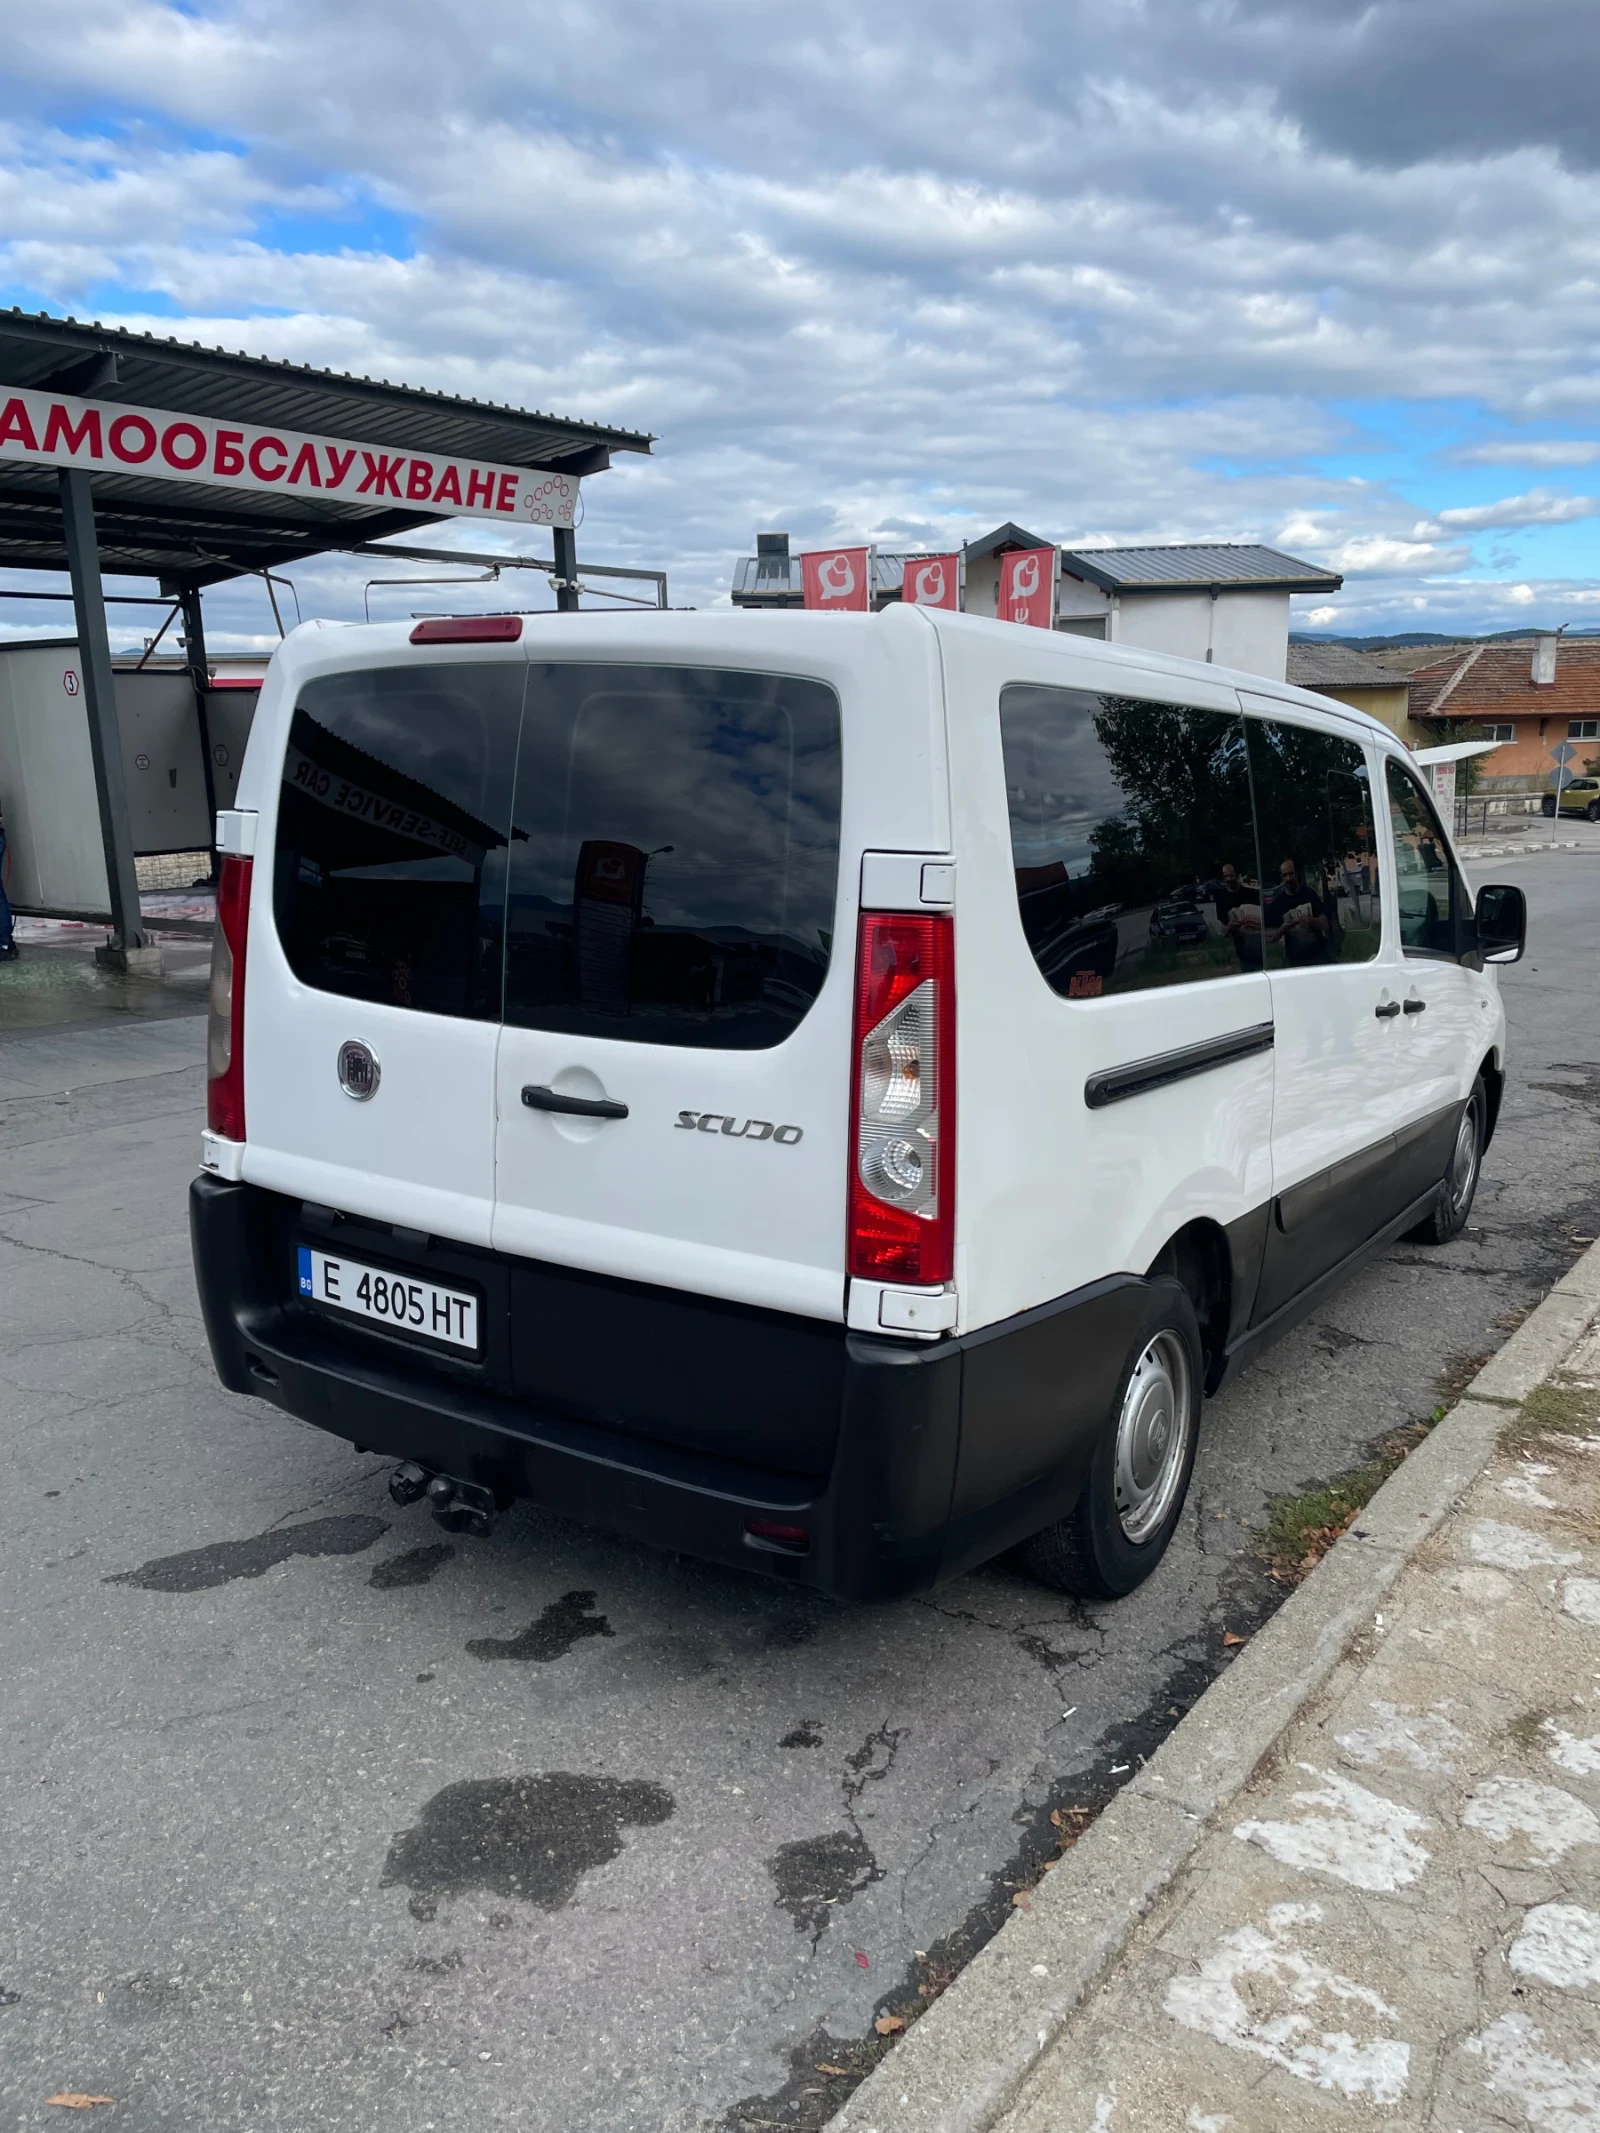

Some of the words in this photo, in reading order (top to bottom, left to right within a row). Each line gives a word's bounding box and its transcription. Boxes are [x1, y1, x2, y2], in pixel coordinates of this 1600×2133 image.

[0, 397, 519, 512] АМООБСЛУЖВАНЕ
[67, 675, 74, 692] 3
[1068, 970, 1103, 996] KTM
[674, 1110, 804, 1145] SCUDO
[301, 1277, 312, 1290] BG
[324, 1260, 341, 1301] E
[356, 1272, 424, 1325] 4805
[432, 1292, 471, 1340] HT
